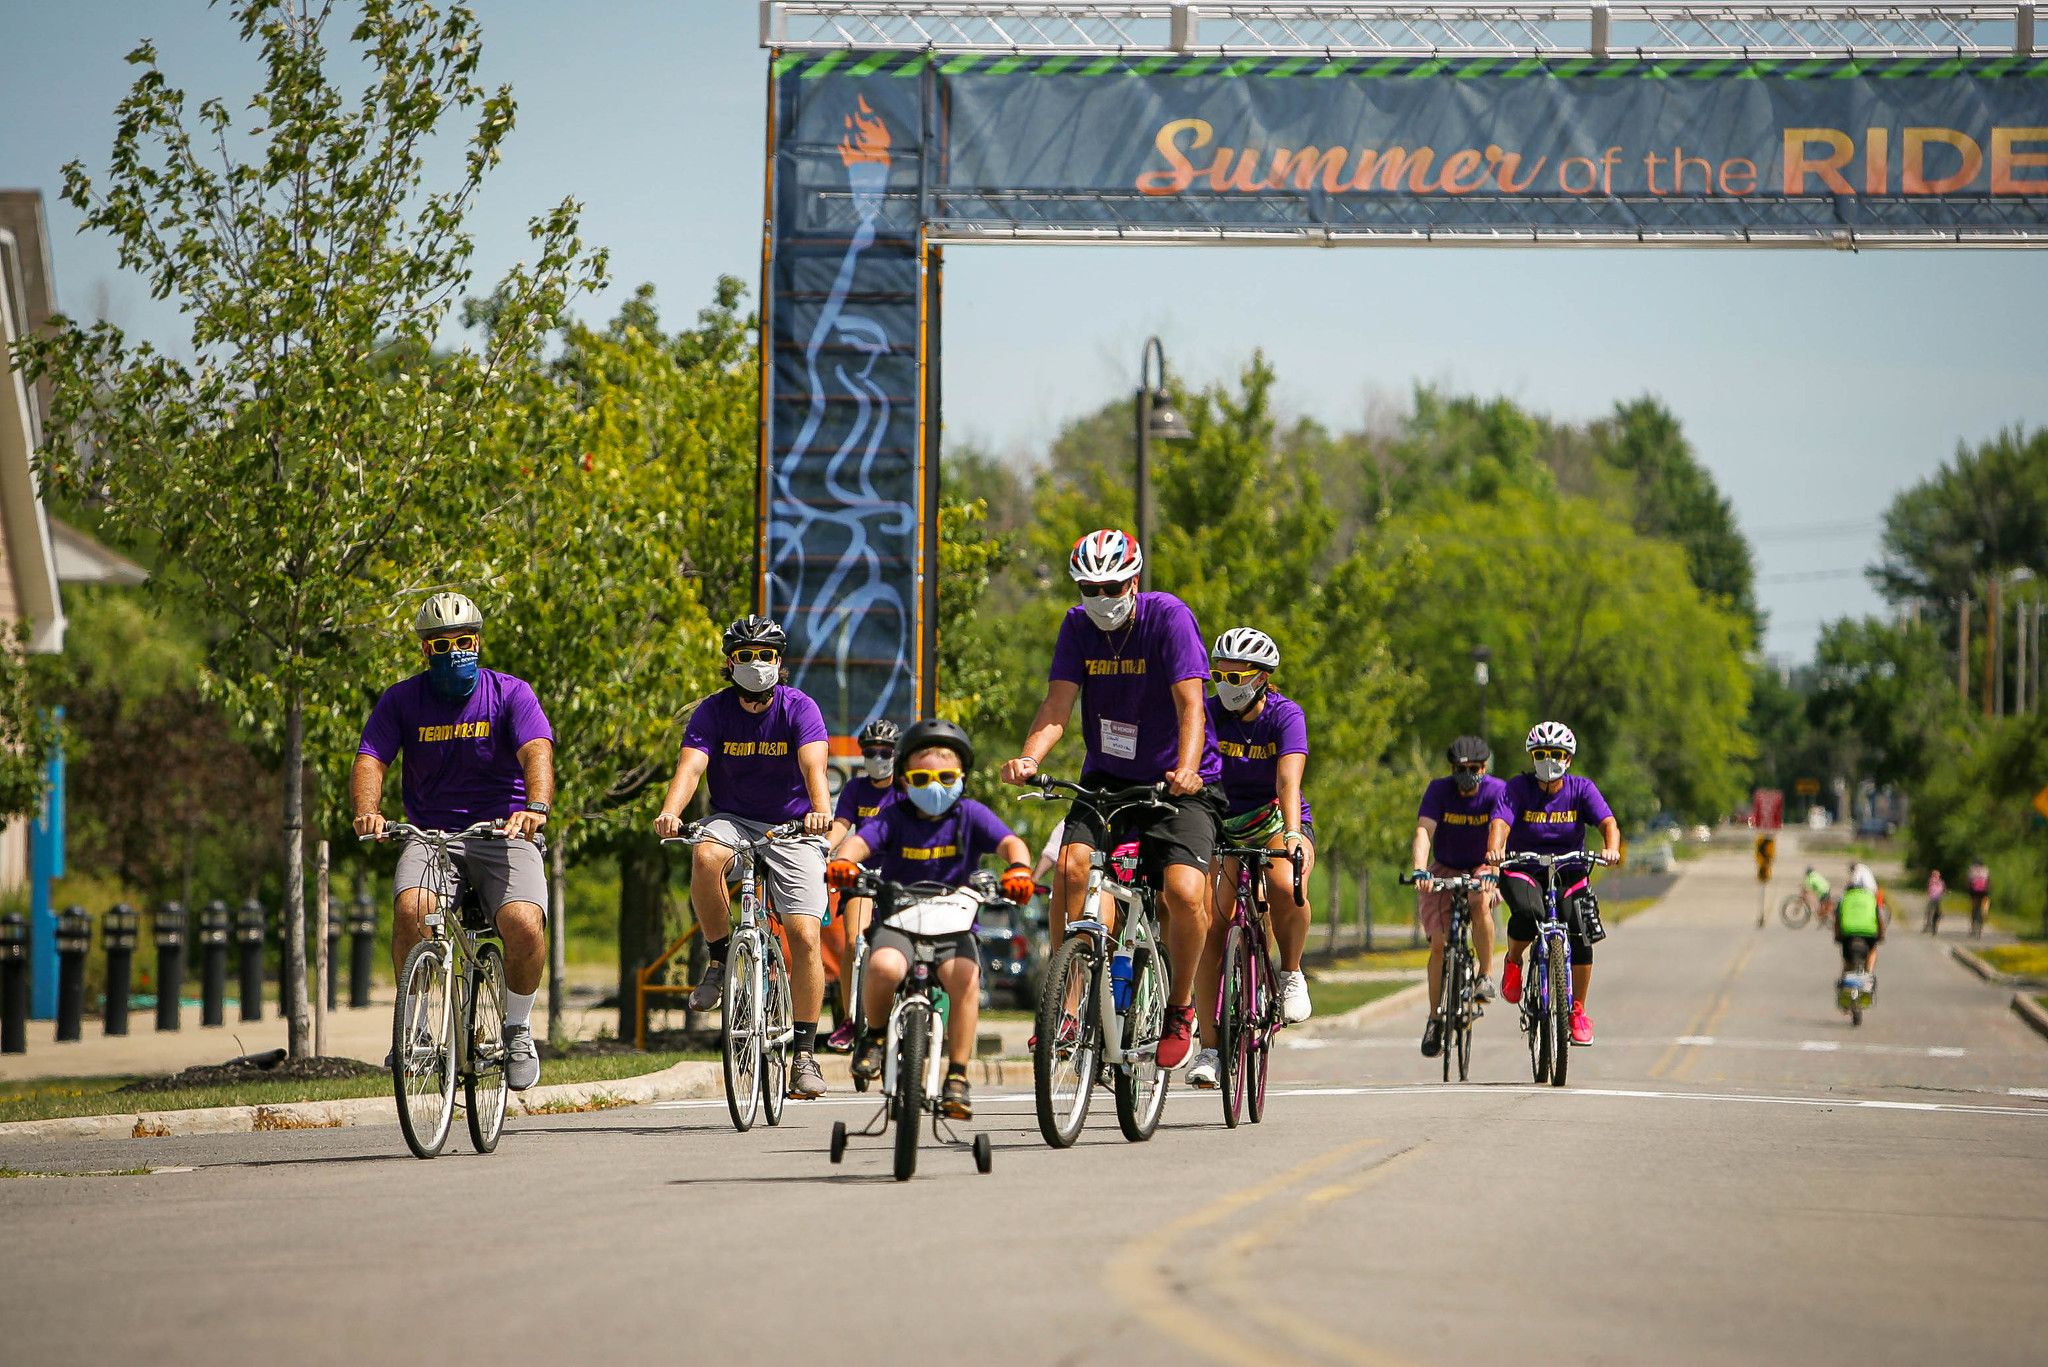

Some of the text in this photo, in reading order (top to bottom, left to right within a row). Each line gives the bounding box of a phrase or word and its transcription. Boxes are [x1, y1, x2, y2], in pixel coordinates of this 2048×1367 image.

[1135, 118, 2048, 195] Summer of the RIDE
[1085, 660, 1119, 675] TEAM
[418, 725, 454, 742] TEAM
[723, 741, 756, 756] TEAM
[1218, 741, 1245, 758] EAM
